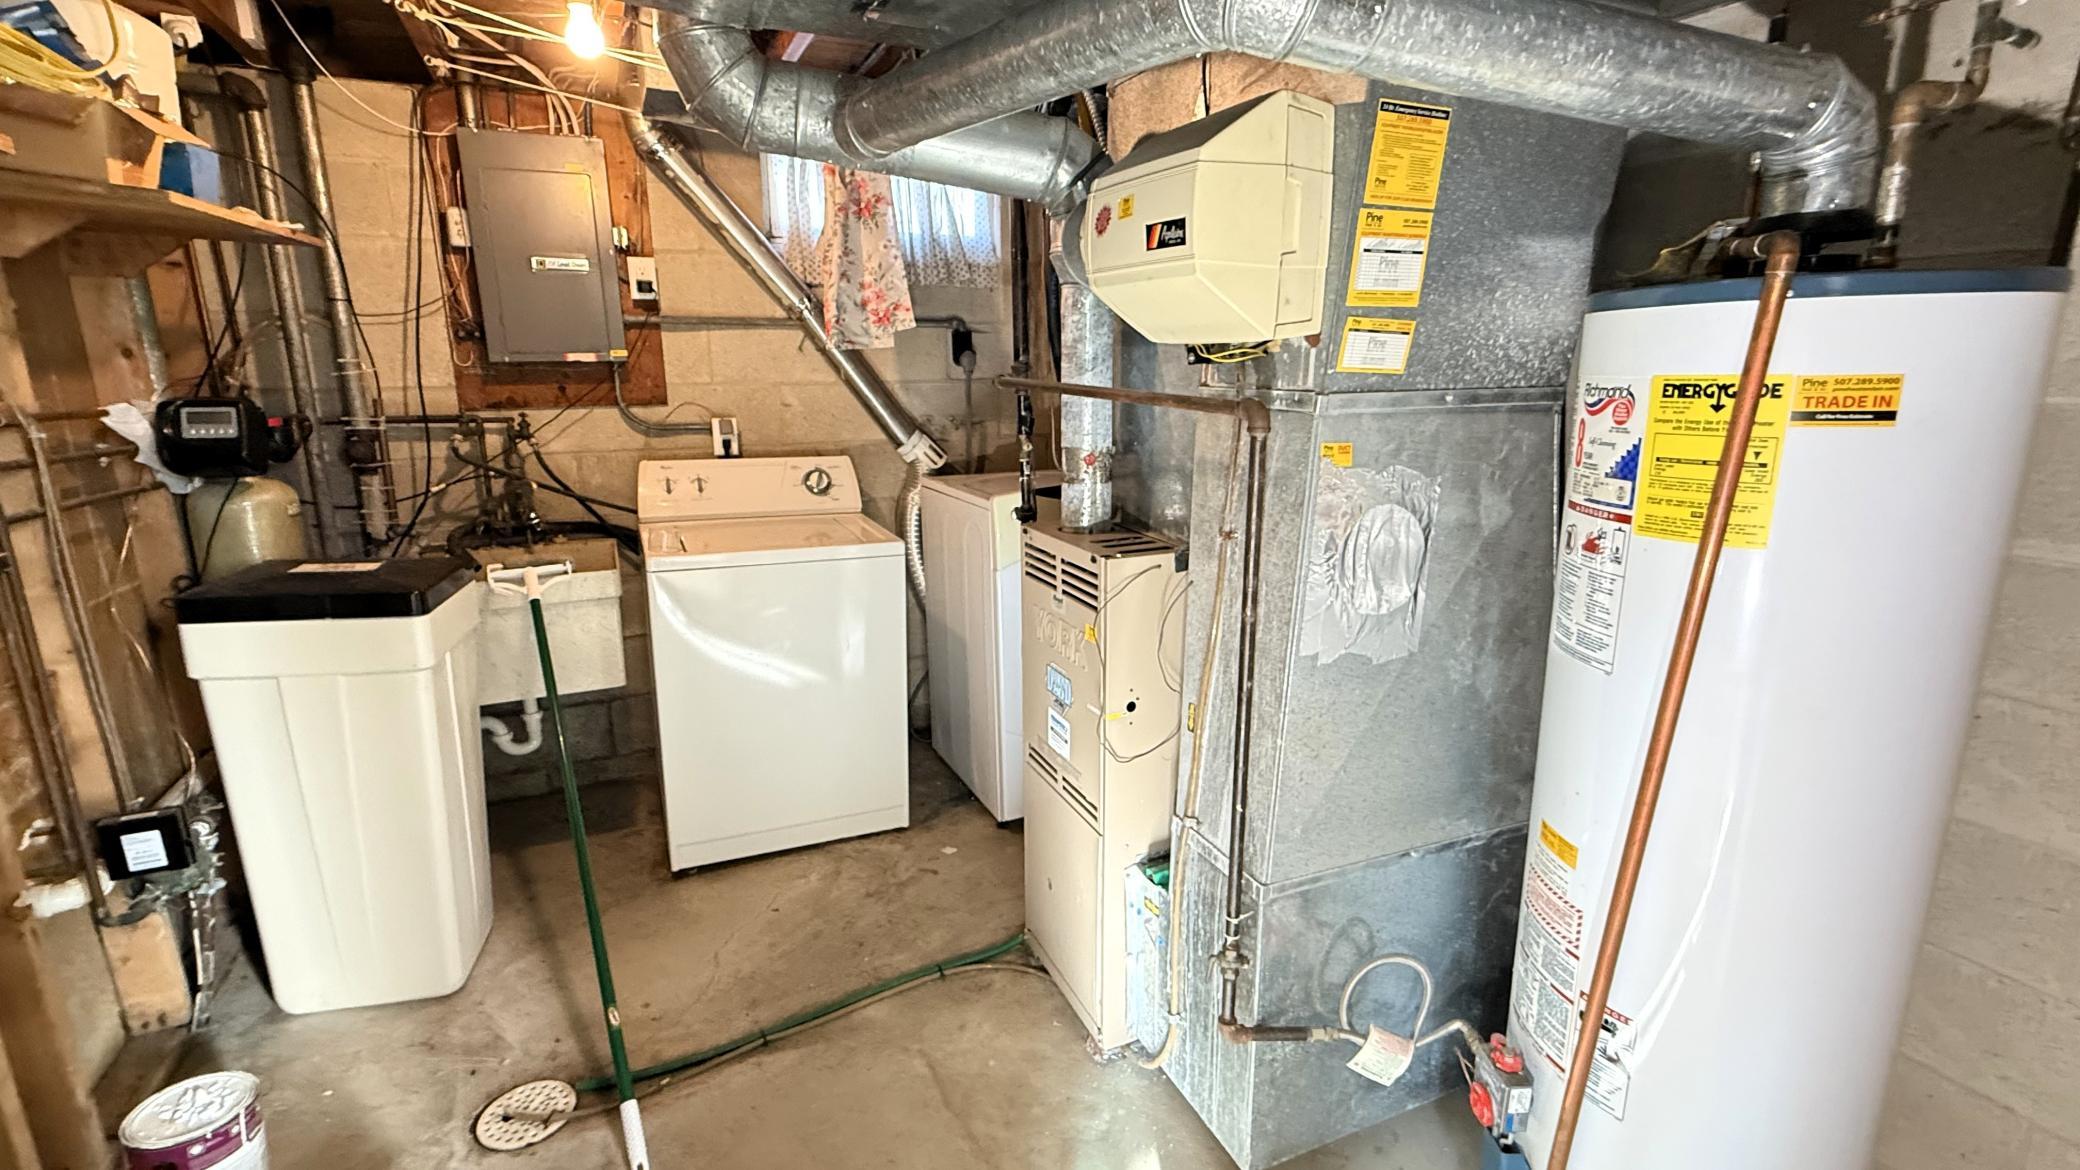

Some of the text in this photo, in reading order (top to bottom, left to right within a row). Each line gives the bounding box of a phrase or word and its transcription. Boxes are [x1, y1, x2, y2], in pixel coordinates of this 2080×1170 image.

[1366, 211, 1384, 222] Pine
[1584, 382, 1631, 399] Richmond
[1802, 378, 1828, 388] Pine
[1662, 383, 1783, 399] ENERGYGDE
[1803, 394, 1894, 409] TRADE IN
[1684, 417, 1702, 426] Energy
[1035, 608, 1087, 667] YORK
